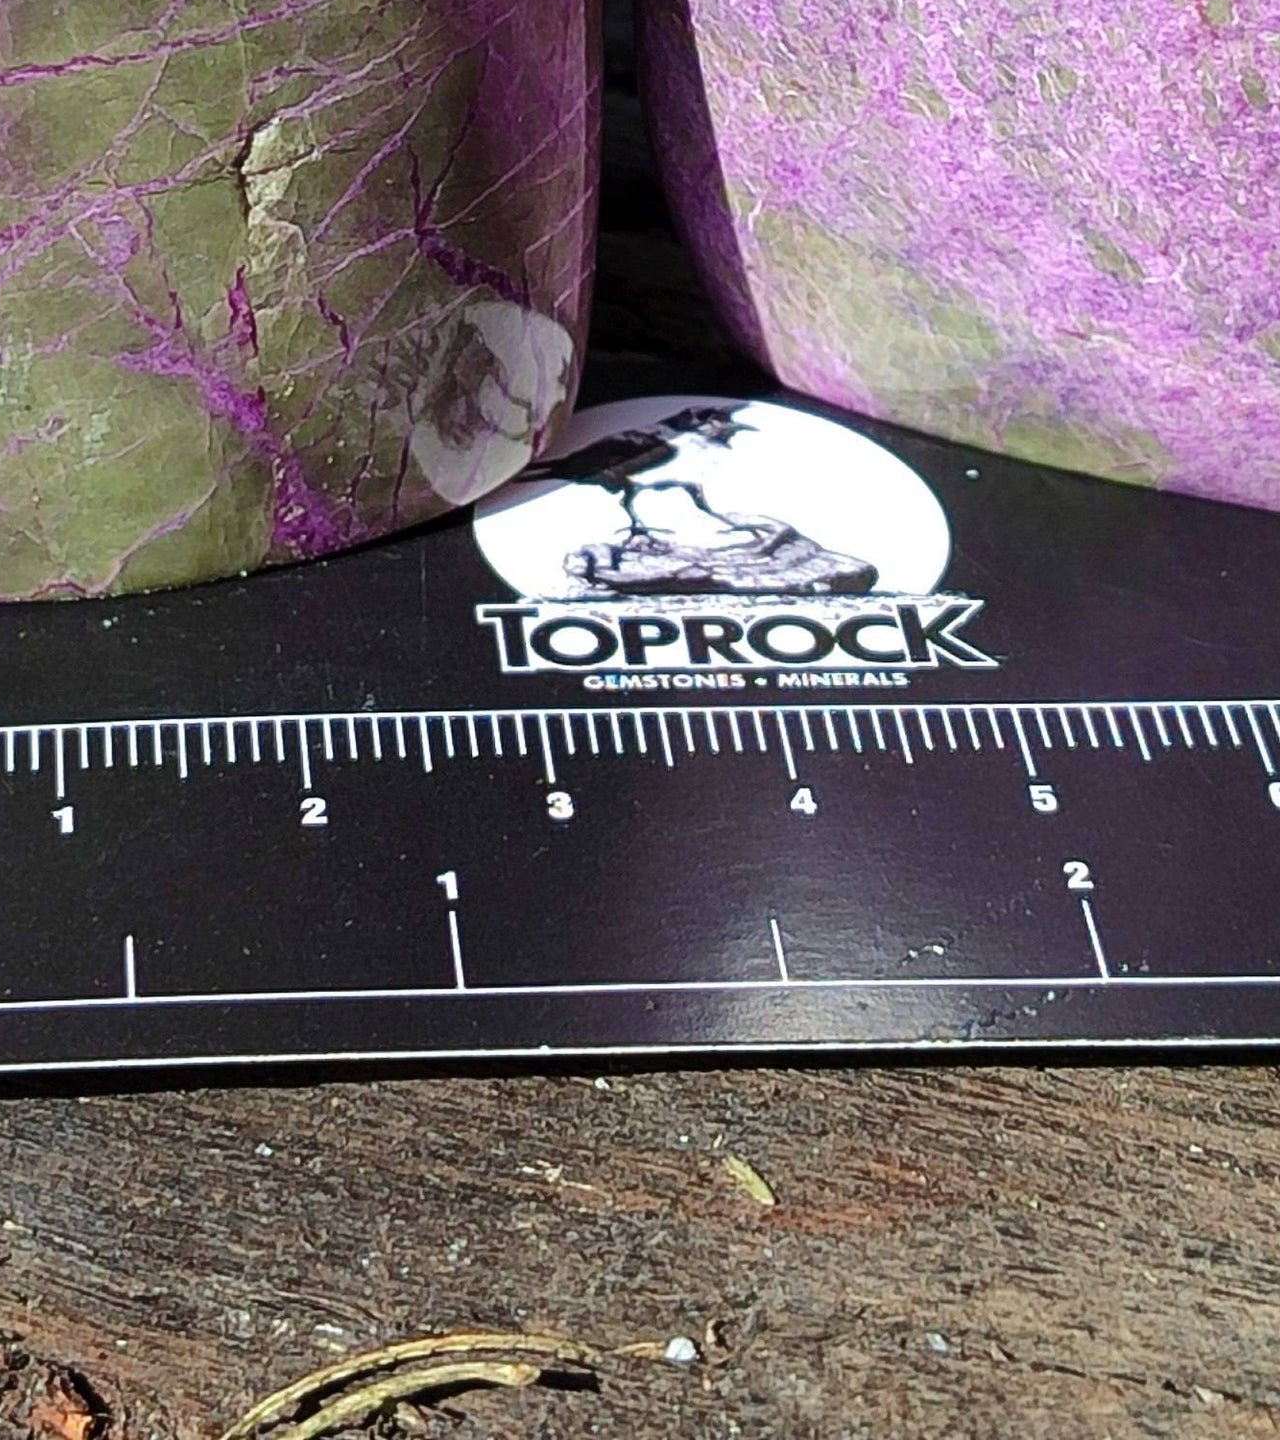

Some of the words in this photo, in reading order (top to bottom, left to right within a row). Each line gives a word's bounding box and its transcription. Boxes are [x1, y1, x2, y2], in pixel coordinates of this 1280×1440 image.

[476, 601, 999, 673] TOPROCK
[582, 672, 747, 691] GEMSTONES
[776, 670, 911, 688] MINERALS
[52, 806, 74, 834] 1
[300, 797, 328, 825] 2
[546, 791, 575, 820] 3
[790, 787, 818, 815] 4
[1028, 784, 1058, 813] 5
[436, 870, 459, 900] 1
[1063, 861, 1095, 890] 2
